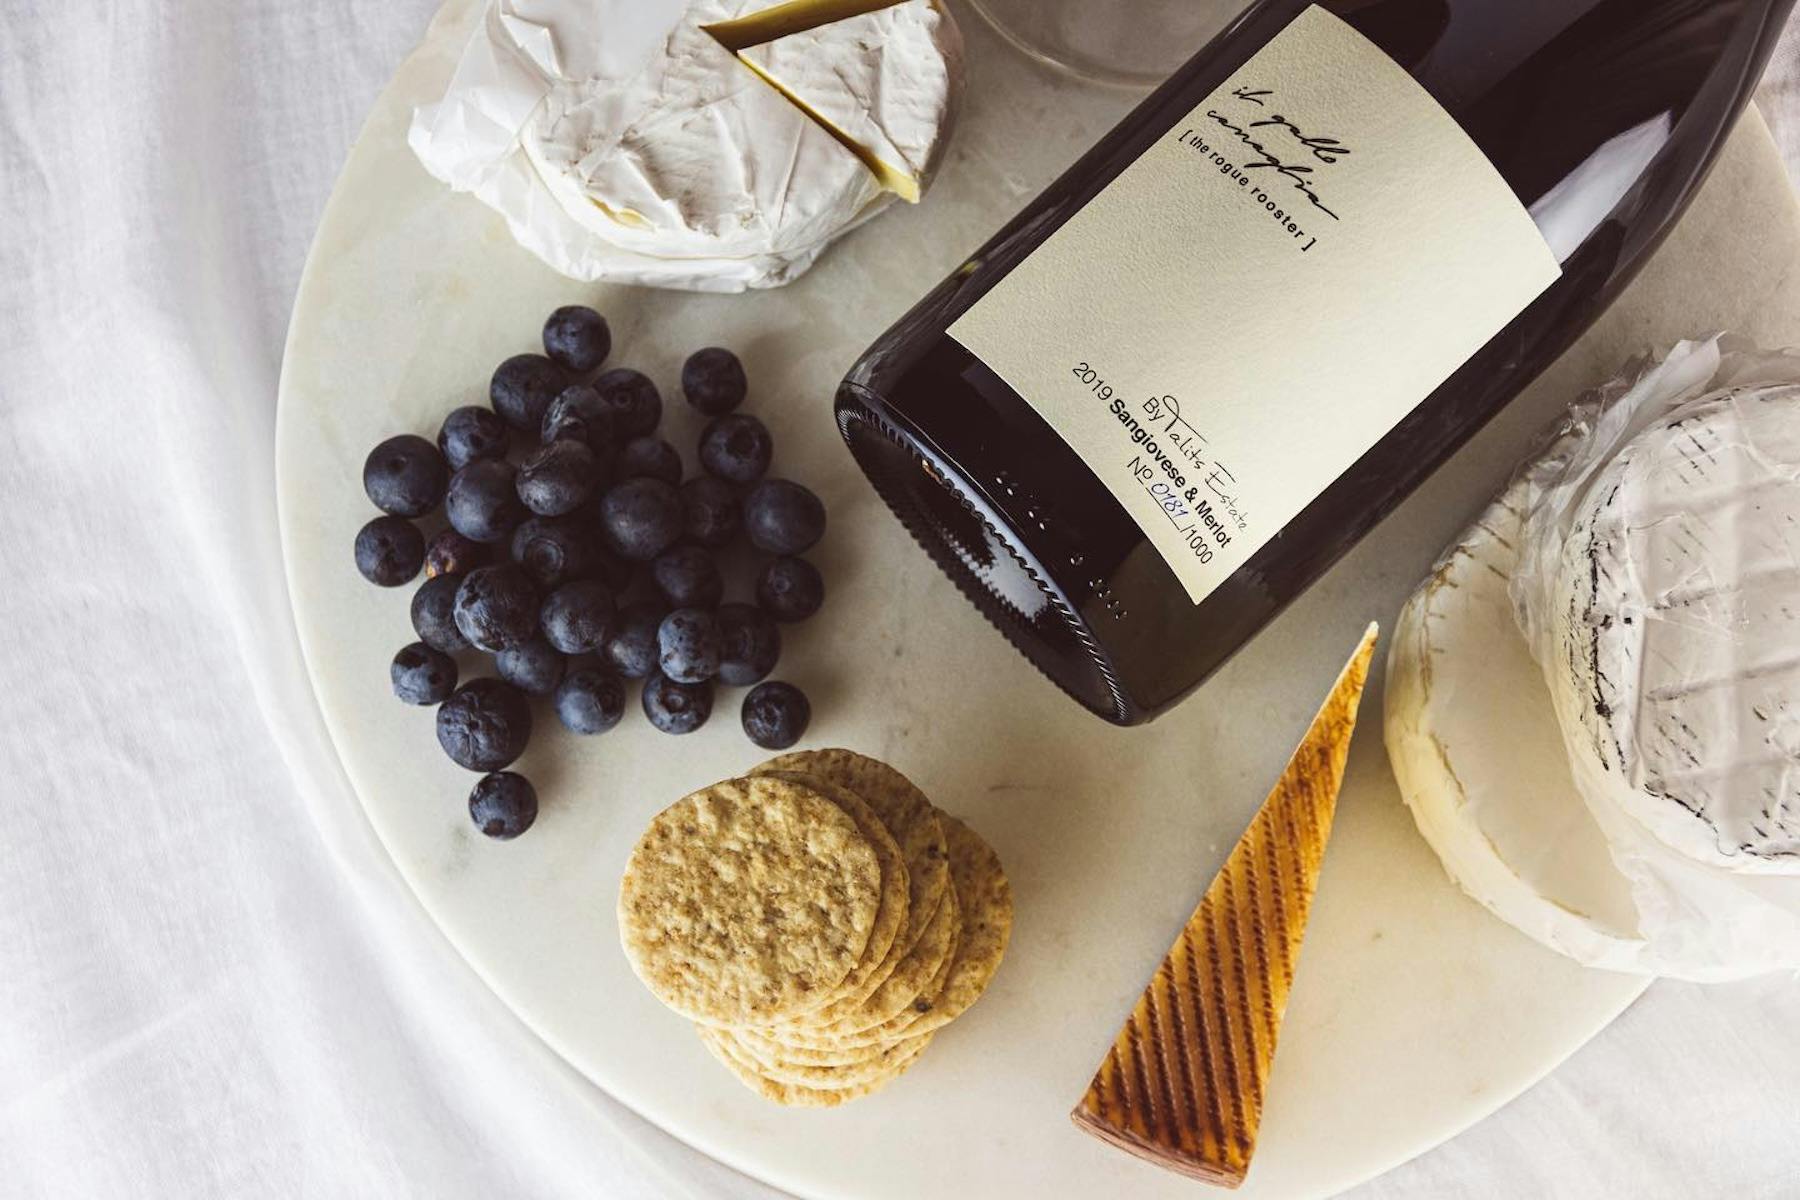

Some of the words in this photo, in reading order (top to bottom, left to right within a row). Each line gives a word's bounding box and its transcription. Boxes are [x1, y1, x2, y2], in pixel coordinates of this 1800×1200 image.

[1232, 86, 1273, 107] il
[1189, 135, 1210, 154] the
[1208, 151, 1250, 186] rogue
[1250, 187, 1305, 238] rooster
[1072, 361, 1113, 401] 2019
[1109, 398, 1186, 488] Sangiovese
[1184, 487, 1198, 503] &
[1194, 499, 1233, 549] Merlot
[1142, 396, 1165, 422] By
[1162, 394, 1208, 470] Talits
[1204, 461, 1250, 531] Estate
